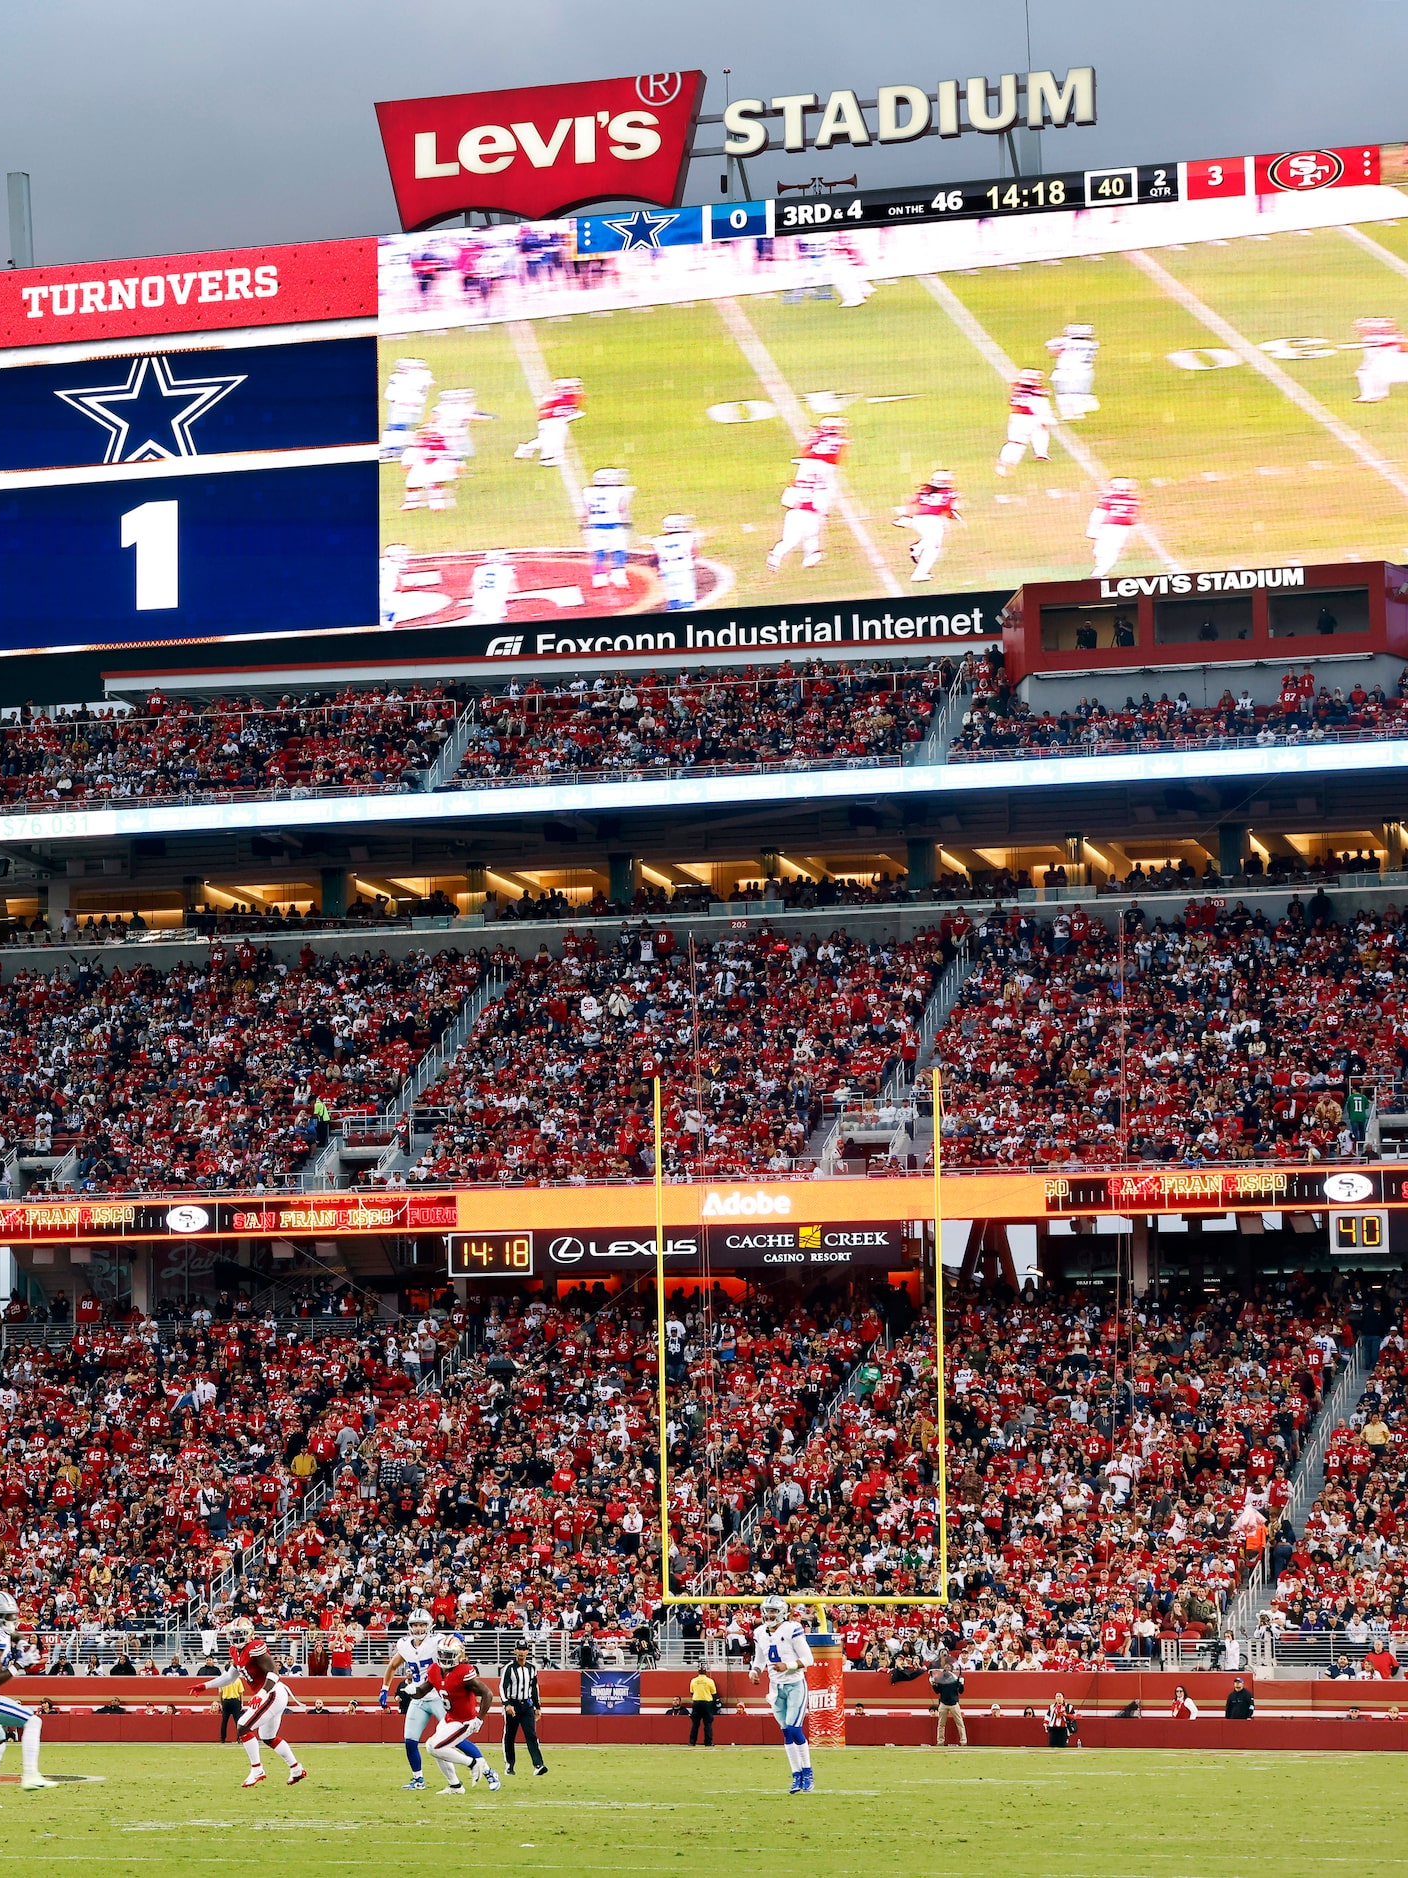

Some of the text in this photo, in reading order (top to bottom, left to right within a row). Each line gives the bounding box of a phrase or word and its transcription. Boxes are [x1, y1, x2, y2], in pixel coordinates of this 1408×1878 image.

[722, 65, 1096, 157] STADIUM
[1154, 170, 1167, 187] 2
[1207, 166, 1222, 187] 3
[1098, 177, 1125, 197] 40
[1149, 186, 1171, 197] QTR
[986, 180, 1065, 209] 14:18
[887, 190, 963, 216] ON THE 46
[783, 202, 831, 226] 3RD
[847, 199, 863, 220] 4
[730, 209, 746, 229] 0
[22, 265, 278, 318] TURNOVERS
[120, 500, 179, 610] 1
[1197, 567, 1304, 593] STADIUM
[536, 632, 675, 654] Foxconn
[686, 615, 841, 649] Industrial
[852, 607, 983, 640] Internet
[1284, 692, 1296, 702] 87
[1211, 899, 1224, 908] 03
[1074, 922, 1084, 931] 97
[204, 1061, 216, 1069] 97
[642, 1061, 653, 1071] 23
[1354, 1102, 1363, 1112] 11
[1160, 1174, 1287, 1193] FRANCISCO
[702, 1191, 791, 1216] Adobe
[24, 1207, 135, 1225] FRANCISCO
[233, 1208, 393, 1229] SAN FRANCISCO
[1339, 1216, 1380, 1245] 40
[725, 1231, 889, 1250] CACHE CREEK
[461, 1239, 529, 1266] 14:18
[589, 1240, 697, 1257] LEXUS
[763, 1251, 852, 1263] CASINO RESORT
[81, 1301, 93, 1309] 80
[453, 1314, 463, 1324] 97
[78, 1336, 84, 1344] 8
[1309, 1355, 1319, 1364] 16
[330, 1364, 341, 1373] 97
[268, 1371, 280, 1380] 54
[735, 1376, 746, 1385] 97
[528, 1387, 540, 1396] 54
[149, 1418, 160, 1427] 85
[254, 1420, 259, 1428] 1
[34, 1438, 44, 1446] 16
[1089, 1443, 1099, 1453] 13
[88, 1451, 100, 1461] 42
[1252, 1456, 1265, 1467] 54
[1329, 1457, 1339, 1467] 13
[29, 1469, 40, 1479] 23
[773, 1468, 780, 1478] 5
[56, 1487, 67, 1497] 23
[263, 1482, 275, 1492] 23
[491, 1501, 500, 1511] 11
[183, 1511, 193, 1521] 97
[688, 1512, 700, 1522] 85
[100, 1519, 110, 1529] 19
[1075, 1588, 1086, 1597] 23
[1321, 1598, 1332, 1607] 97
[844, 1632, 859, 1643] 27
[899, 1628, 911, 1637] 85
[966, 1628, 973, 1637] 9
[1105, 1630, 1116, 1641] 13
[44, 1636, 58, 1644] 101
[768, 1644, 781, 1663] 4
